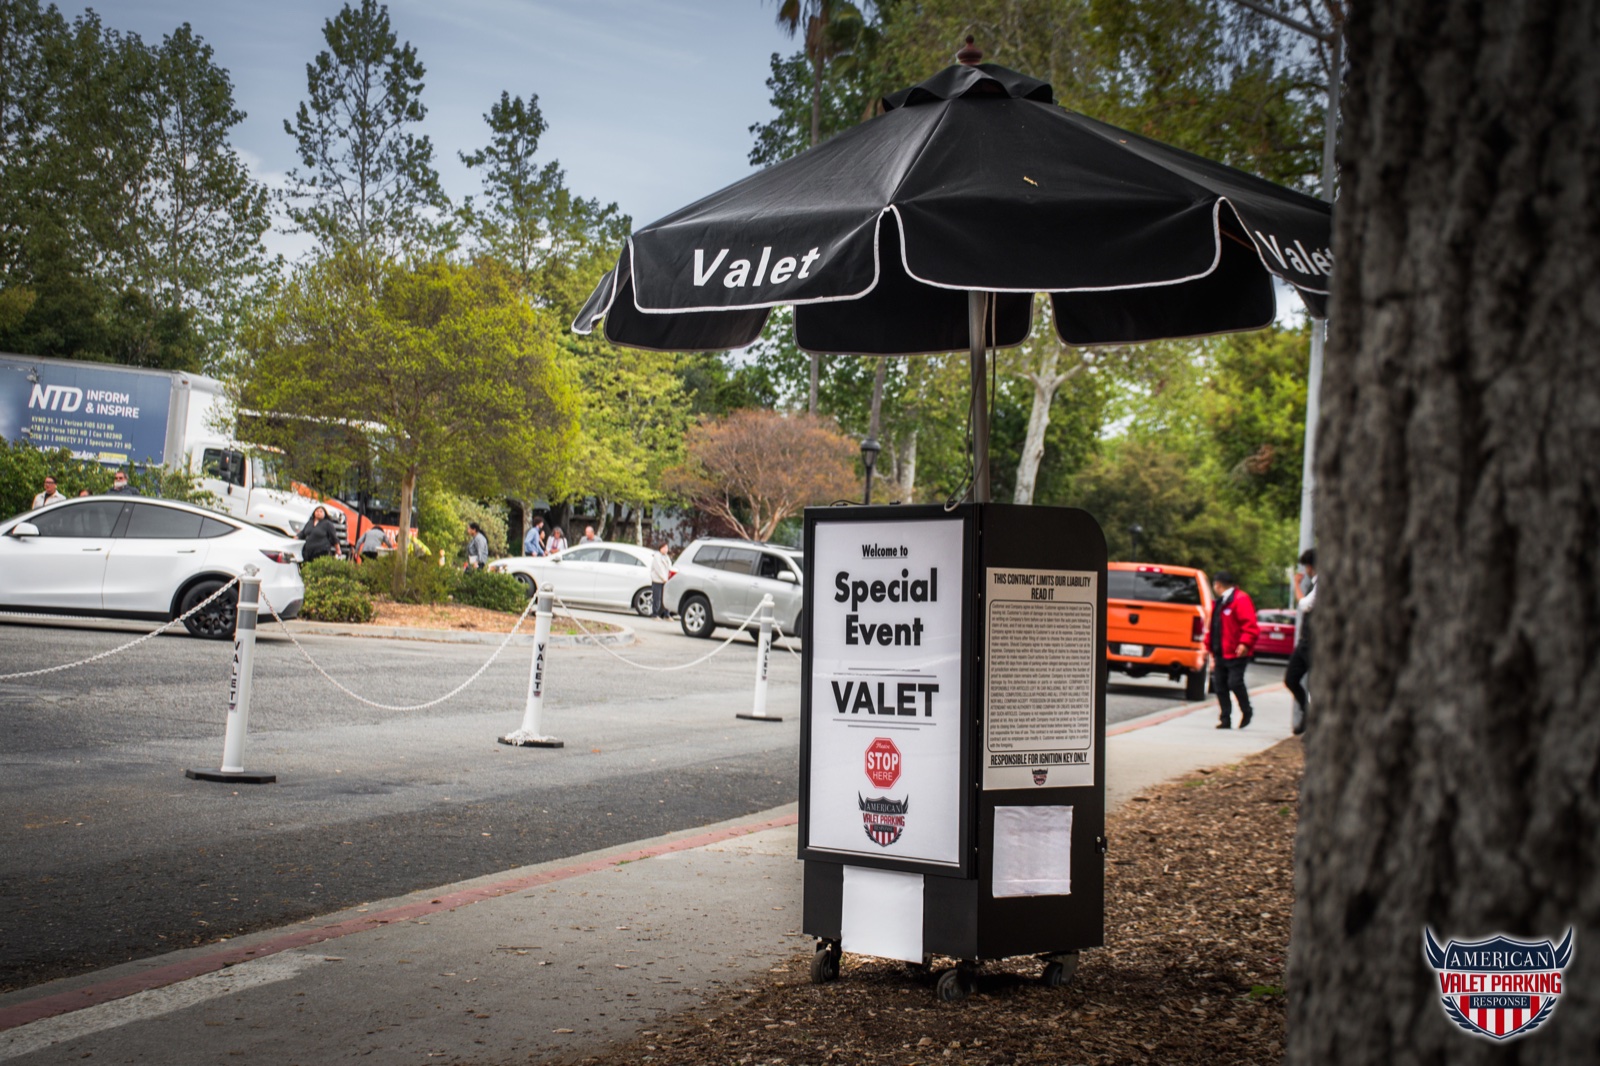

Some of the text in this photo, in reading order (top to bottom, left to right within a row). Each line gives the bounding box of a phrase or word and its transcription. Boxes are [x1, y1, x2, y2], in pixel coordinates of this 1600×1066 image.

[693, 246, 820, 288] Valet
[28, 383, 129, 413] NTD INFORM
[85, 402, 140, 419] & INSPIRE
[861, 543, 909, 558] Welcome to
[994, 573, 1091, 587] THIS CONTRACT LIMITS OUR LIABILITY
[834, 567, 938, 612] Special
[1031, 587, 1055, 600] READ IT
[845, 614, 924, 646] Event
[230, 641, 240, 700] VALET
[534, 643, 545, 690] VALET
[831, 680, 940, 717] VALET
[867, 751, 899, 771] STOP
[991, 752, 1087, 765] RESPONSIBLE FOR IGNITION KEY ONLY
[872, 770, 893, 781] HERE
[866, 802, 901, 813] AMERICAN
[863, 812, 905, 826] VALET PARKING
